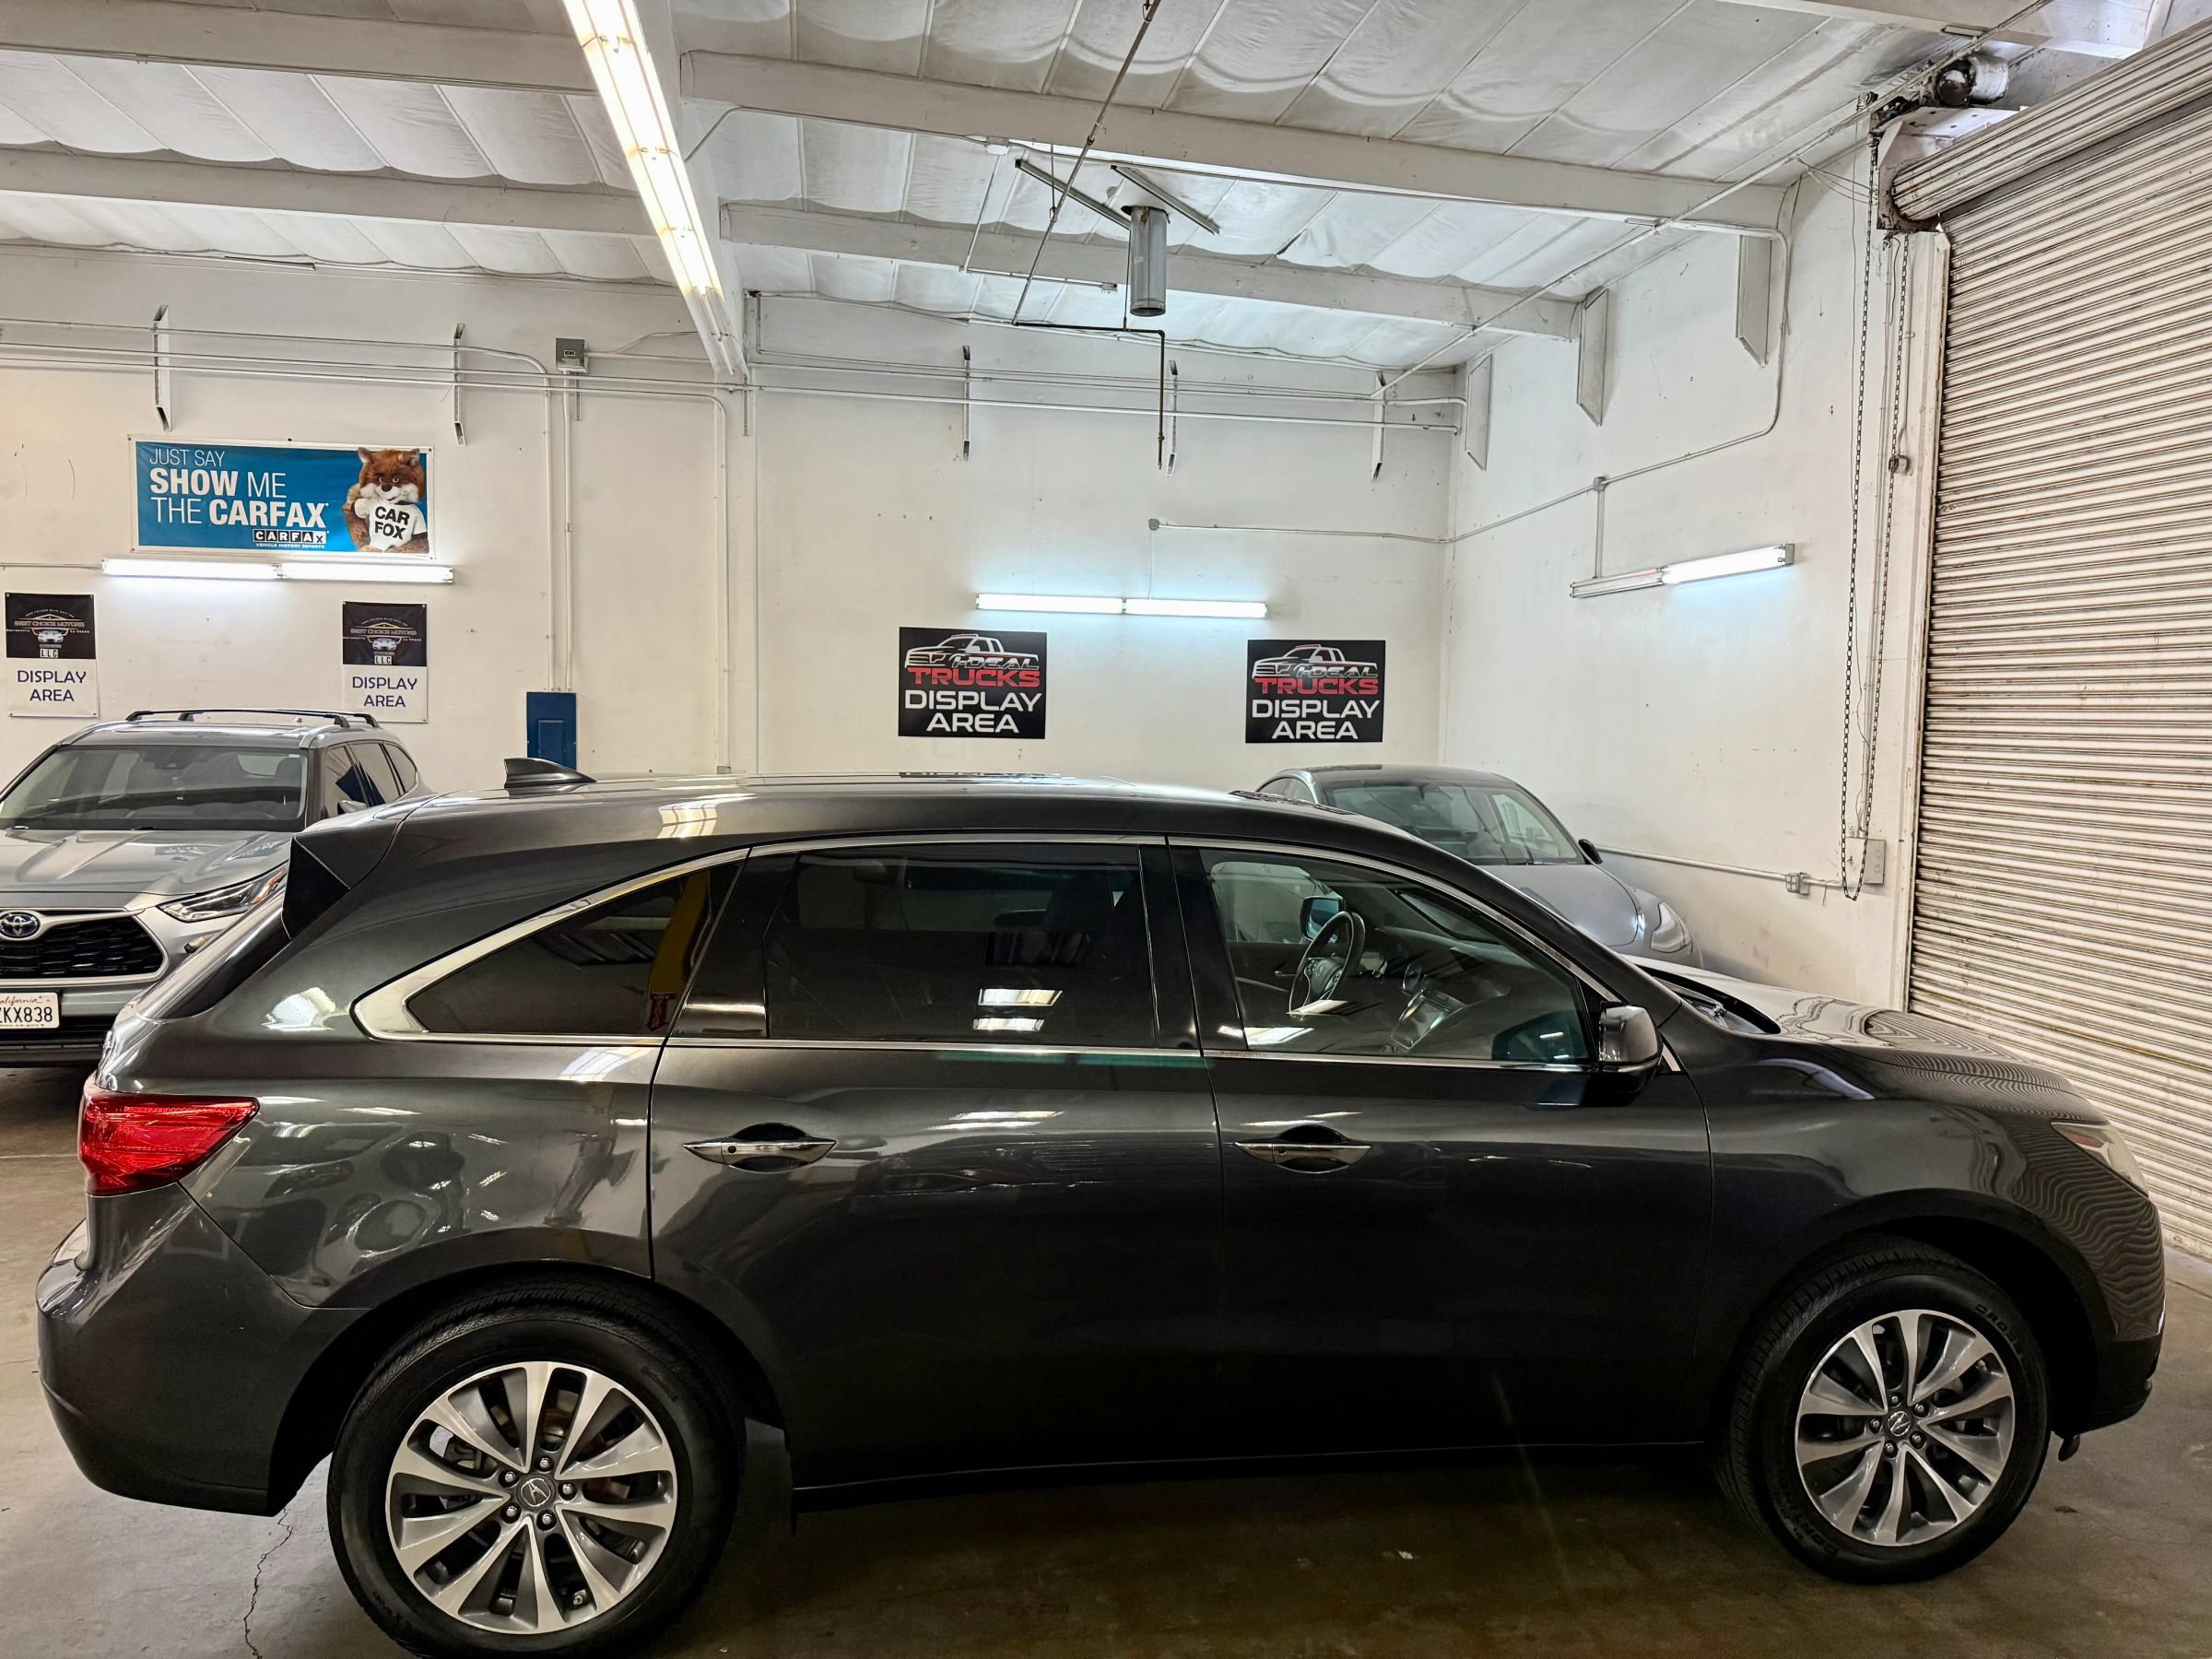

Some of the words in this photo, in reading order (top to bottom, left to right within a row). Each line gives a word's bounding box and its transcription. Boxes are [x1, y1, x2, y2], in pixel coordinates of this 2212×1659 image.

[149, 448, 190, 465] JUST
[194, 450, 226, 467] SAY
[149, 467, 239, 496] SHOW
[247, 471, 288, 498] ME
[150, 497, 203, 524] THE
[209, 499, 327, 528] CARFAX
[374, 506, 411, 525] CAR
[254, 529, 325, 544] CARFAX
[374, 521, 406, 540] FOX
[41, 649, 58, 658] LLC
[18, 670, 87, 683] DISPLAY
[352, 677, 418, 689] DISPLAY
[907, 666, 1041, 688] TRUCKS
[1254, 677, 1379, 695] TRUCKS
[29, 688, 75, 701] AREA
[363, 694, 406, 708] AREA
[904, 689, 1042, 712] DISPLAY
[1252, 699, 1381, 719] DISPLAY
[926, 712, 1019, 734] AREA
[1271, 721, 1359, 740] AREA
[0, 995, 39, 1006] alifornia
